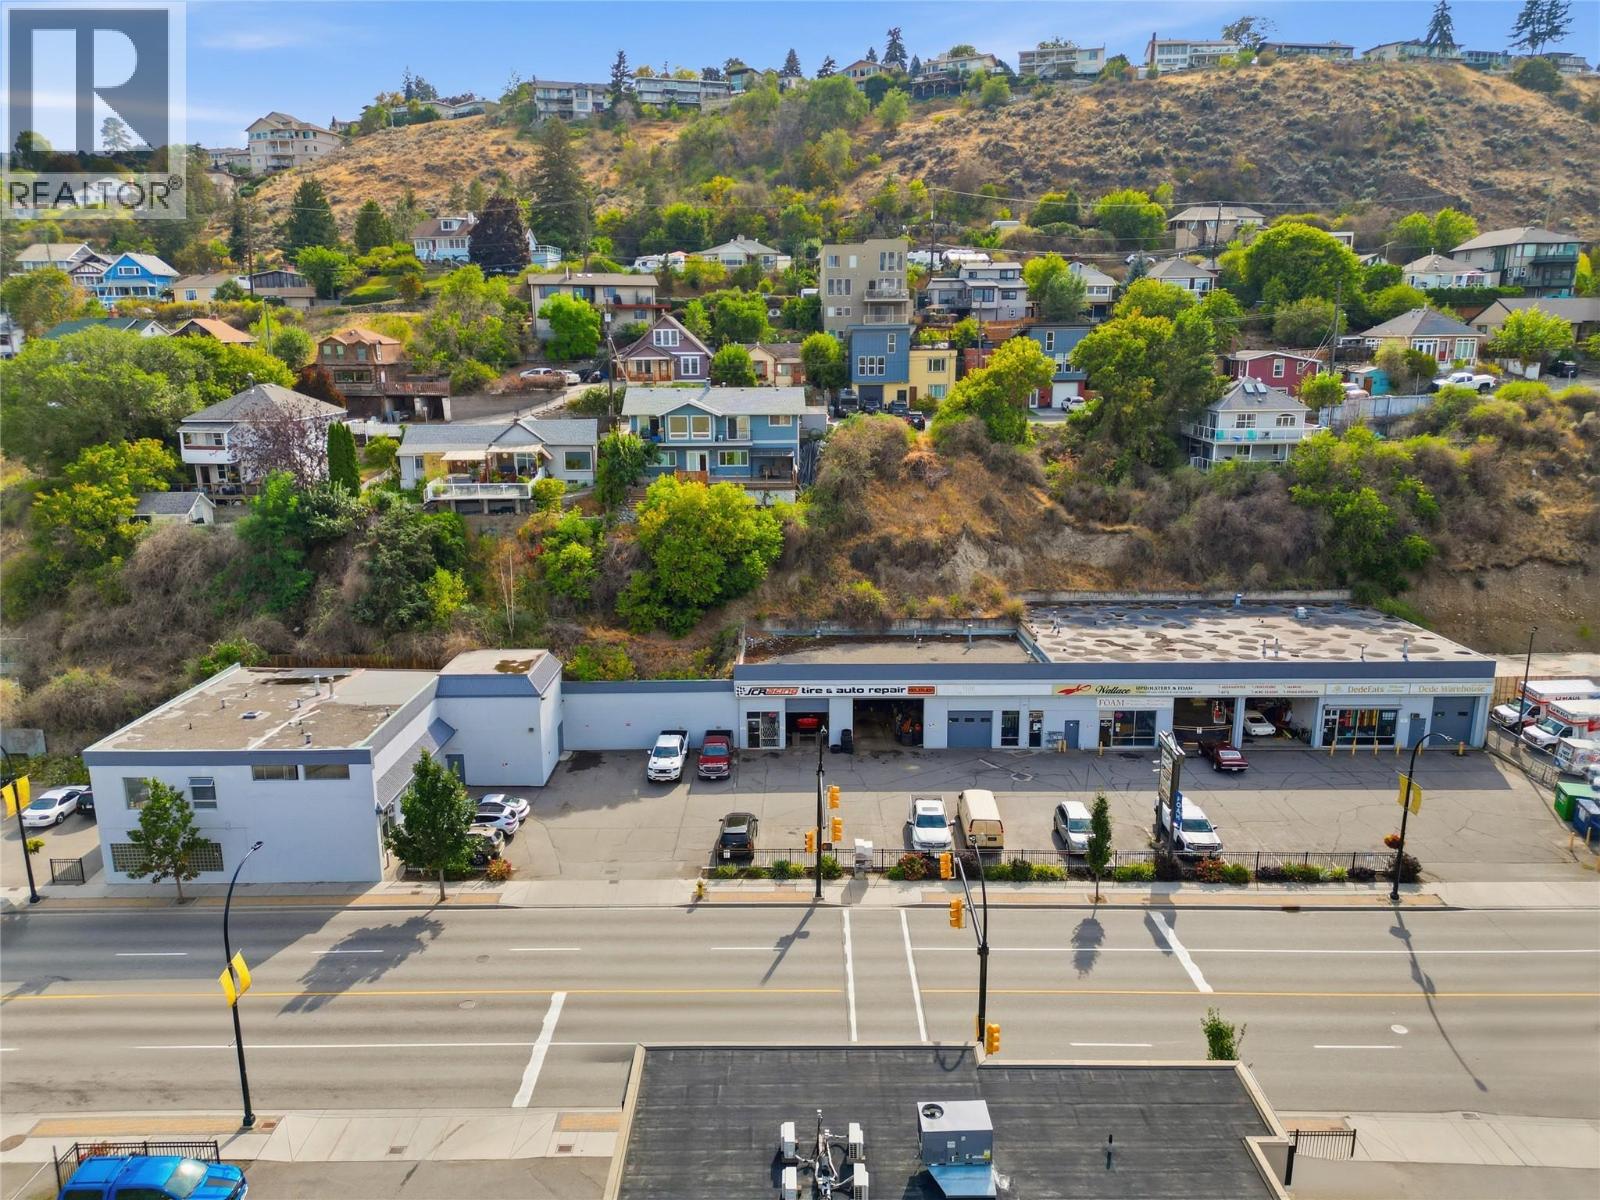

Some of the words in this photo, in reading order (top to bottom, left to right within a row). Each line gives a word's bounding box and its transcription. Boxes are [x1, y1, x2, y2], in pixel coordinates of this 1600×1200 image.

[868, 686, 906, 695] repair
[1095, 685, 1131, 695] Wallace
[1419, 685, 1439, 693] Dede
